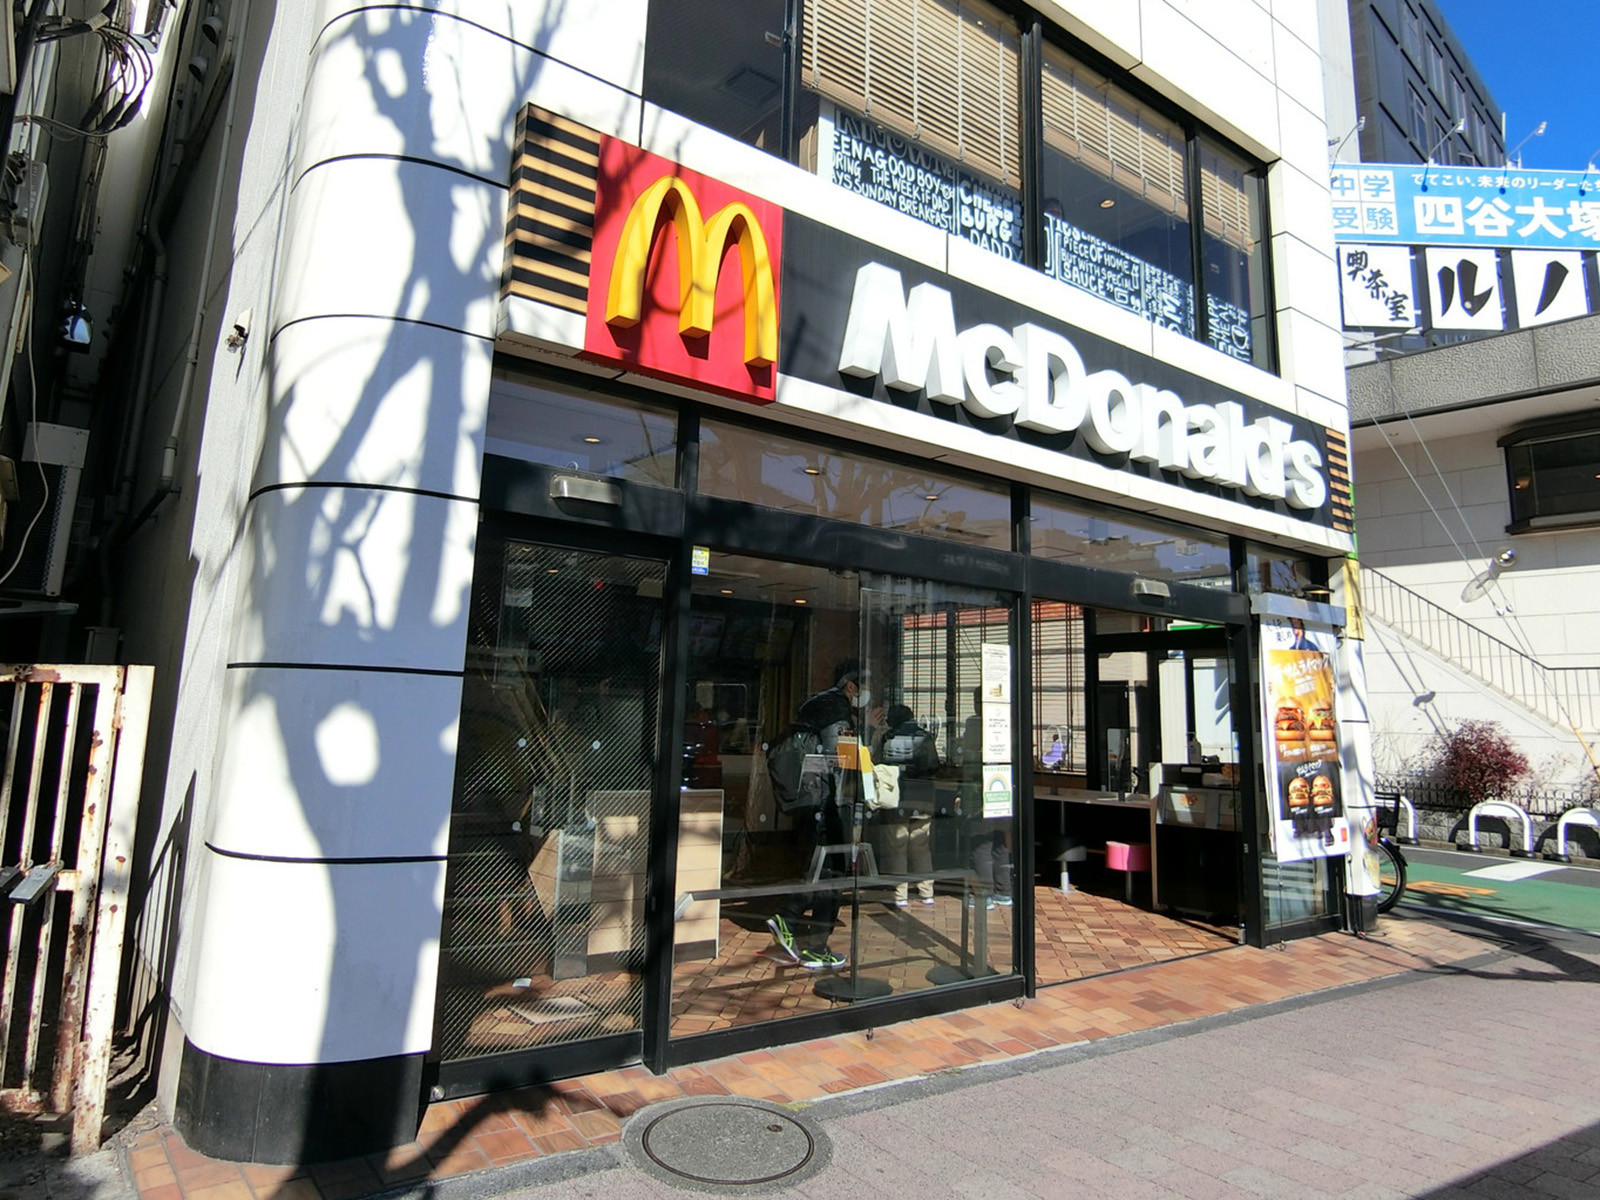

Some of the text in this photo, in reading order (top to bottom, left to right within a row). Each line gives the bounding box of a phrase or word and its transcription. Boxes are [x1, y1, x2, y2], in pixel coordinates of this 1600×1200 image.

[870, 166, 891, 189] THE
[892, 175, 921, 201] WEEK
[931, 193, 950, 212] DAD
[875, 150, 915, 181] GOOD
[917, 168, 941, 195] BOY
[1331, 174, 1391, 198] 中学
[853, 178, 898, 208] SUNDAY
[899, 195, 952, 231] BREAKFAST
[1332, 206, 1395, 231] 受験
[970, 229, 1023, 261] DADDY
[1061, 248, 1078, 265] BUT
[1090, 244, 1104, 264] OF
[1104, 252, 1130, 274] HOME
[1063, 261, 1106, 296] SAUCE
[838, 261, 1325, 510] McDonald's
